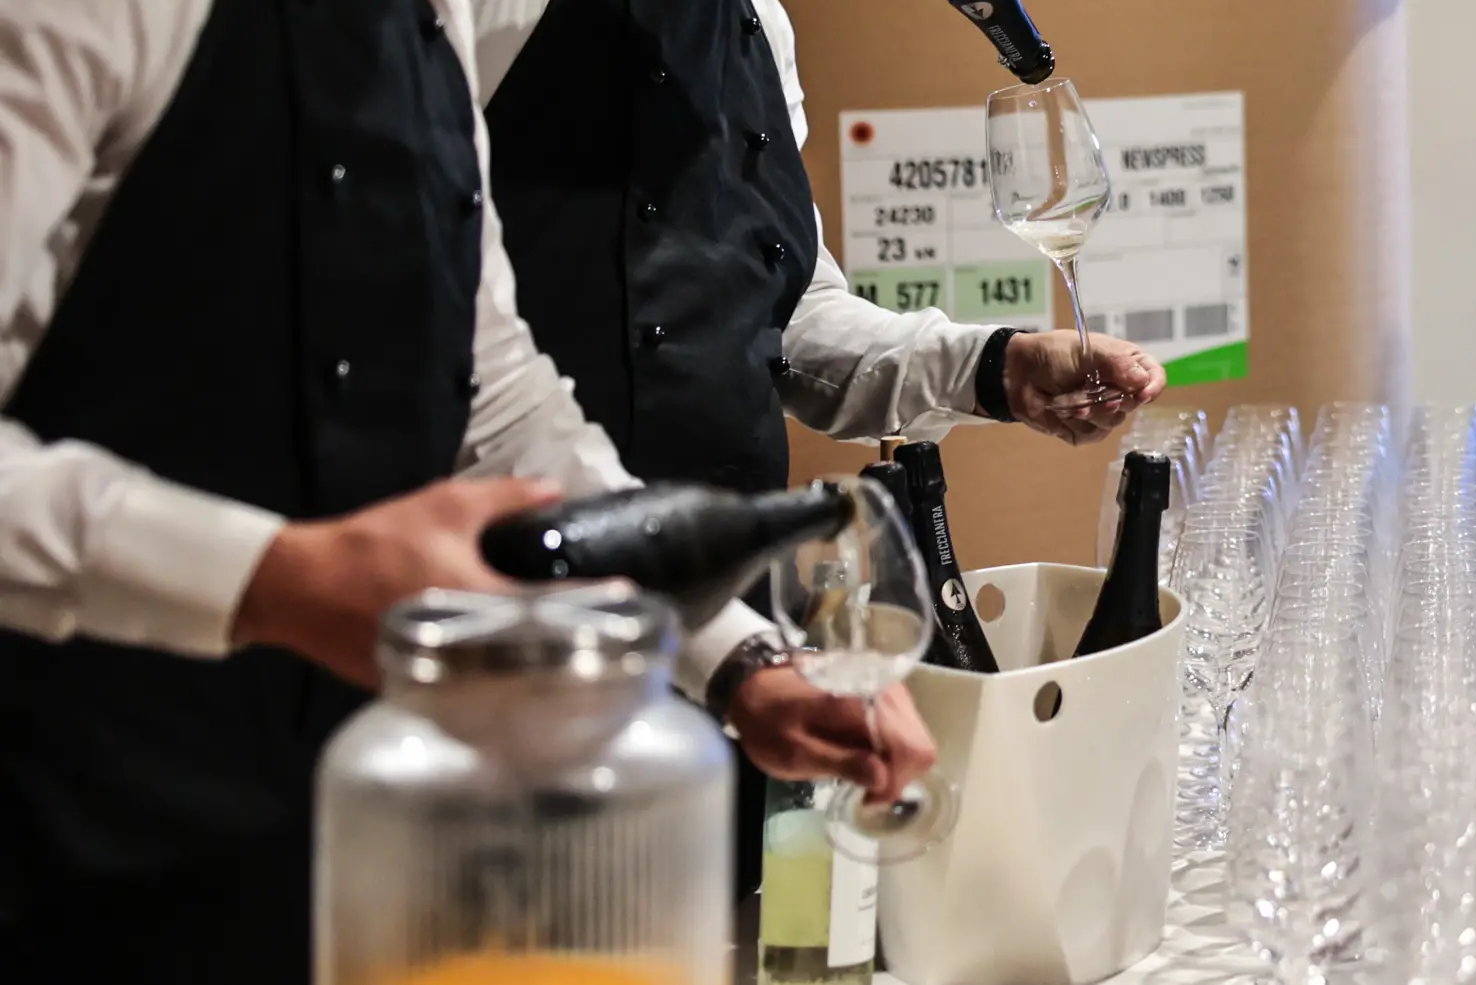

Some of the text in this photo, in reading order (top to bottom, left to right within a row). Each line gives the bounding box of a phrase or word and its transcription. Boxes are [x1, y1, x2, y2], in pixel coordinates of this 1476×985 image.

[877, 236, 907, 262] 23
[895, 280, 941, 310] 577
[980, 276, 1033, 306] 1431
[932, 505, 953, 565] FRECCIANERA
